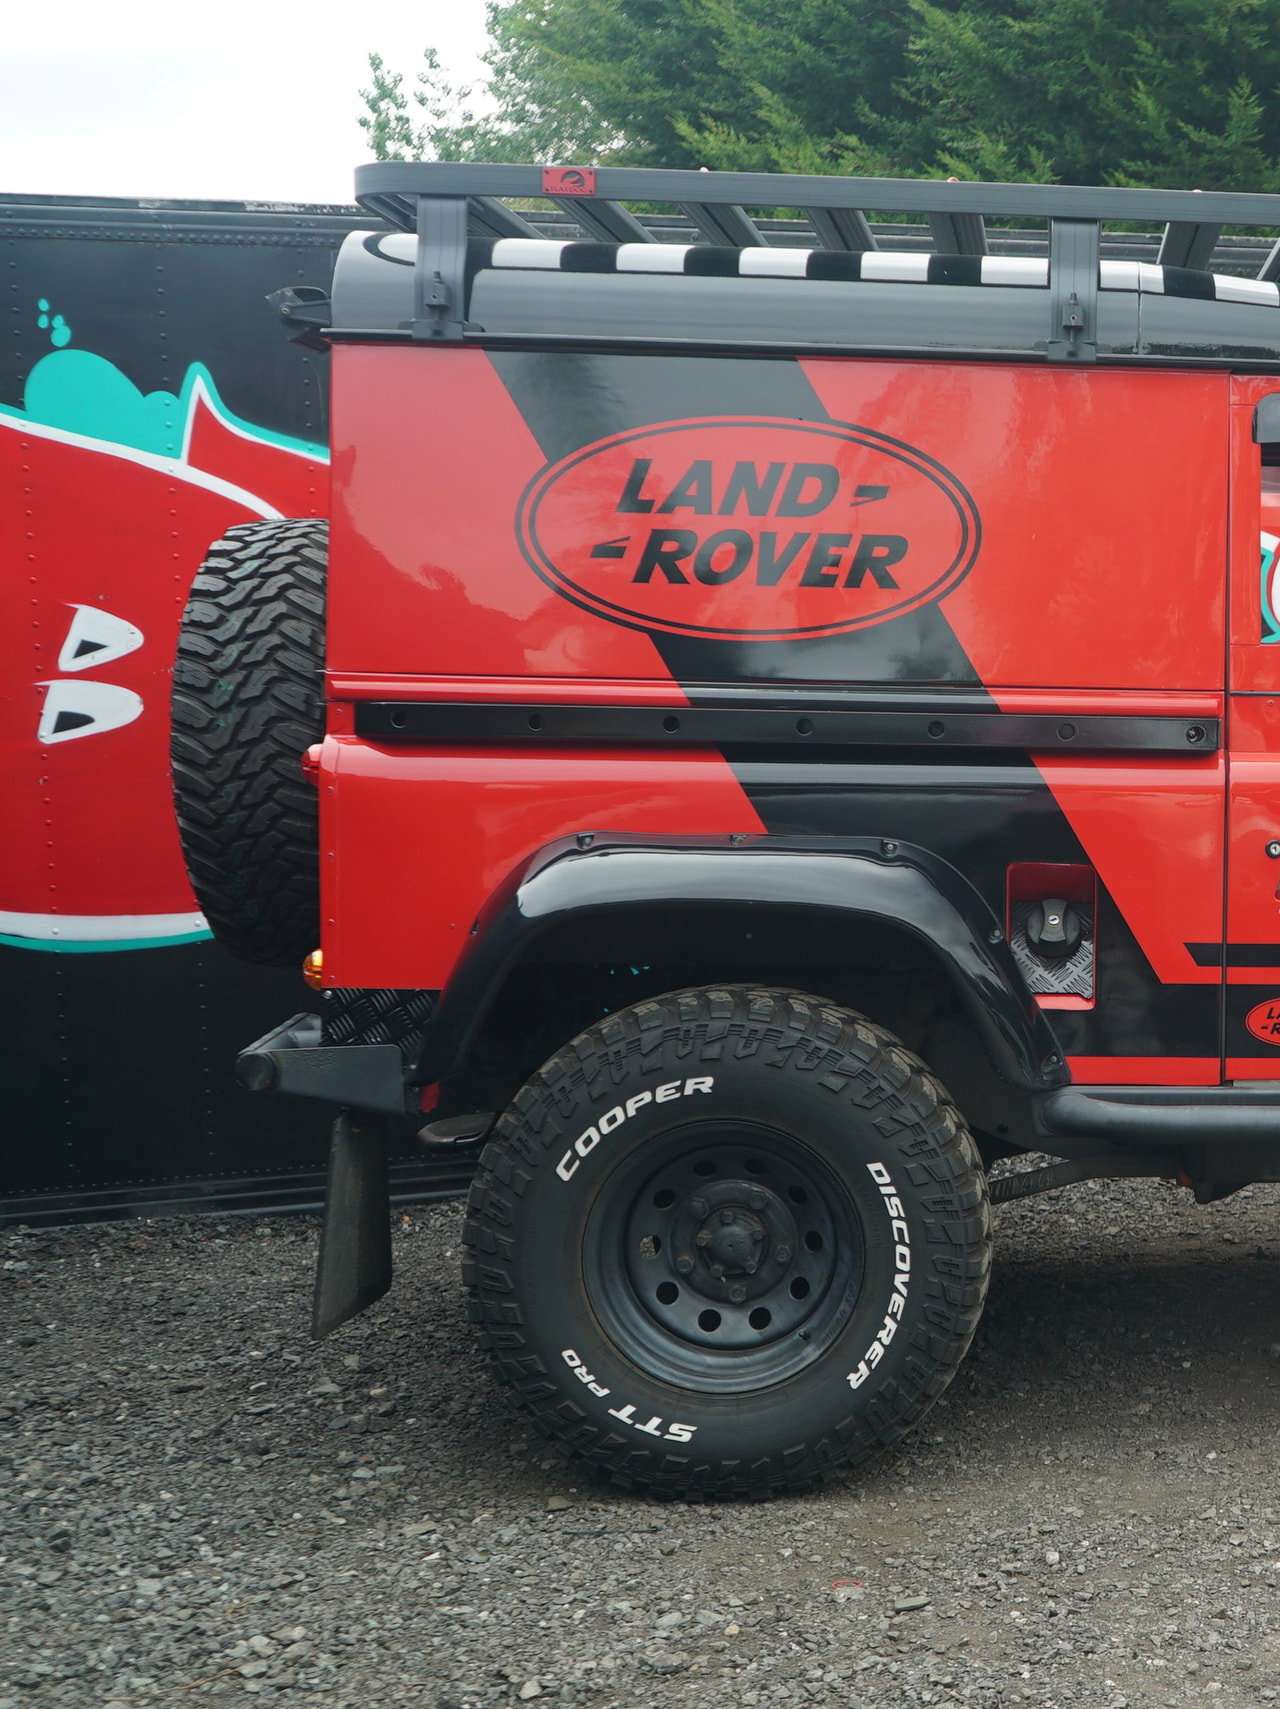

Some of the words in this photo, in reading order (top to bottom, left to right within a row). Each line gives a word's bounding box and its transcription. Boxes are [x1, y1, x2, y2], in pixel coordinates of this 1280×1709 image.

[555, 1075, 714, 1182] COOPER
[846, 1161, 911, 1390] DISCOVERER
[561, 1349, 611, 1398] PRO
[607, 1404, 698, 1443] STT
